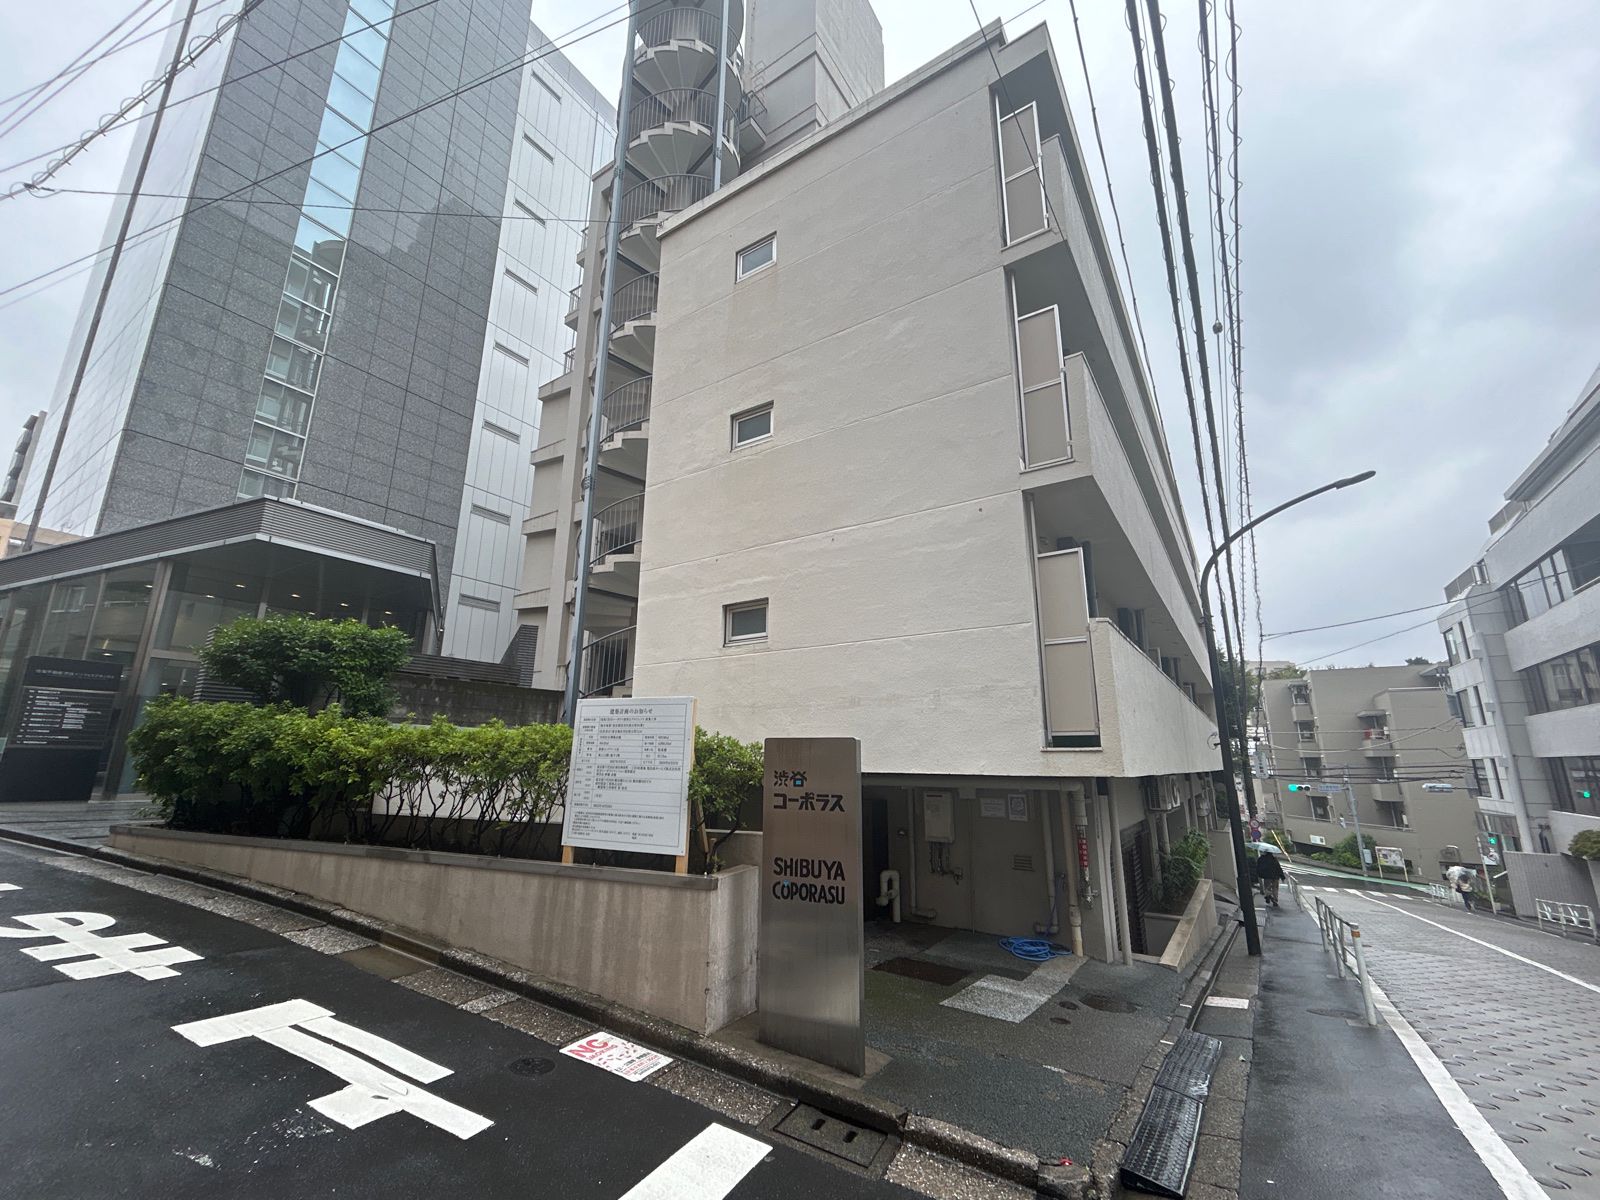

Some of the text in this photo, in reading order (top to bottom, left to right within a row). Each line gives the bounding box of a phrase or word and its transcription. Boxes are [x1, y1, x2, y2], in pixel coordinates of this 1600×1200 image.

[773, 770, 808, 787] 渋谷
[773, 791, 846, 812] コーポラス
[773, 857, 846, 881] SHIBUYA
